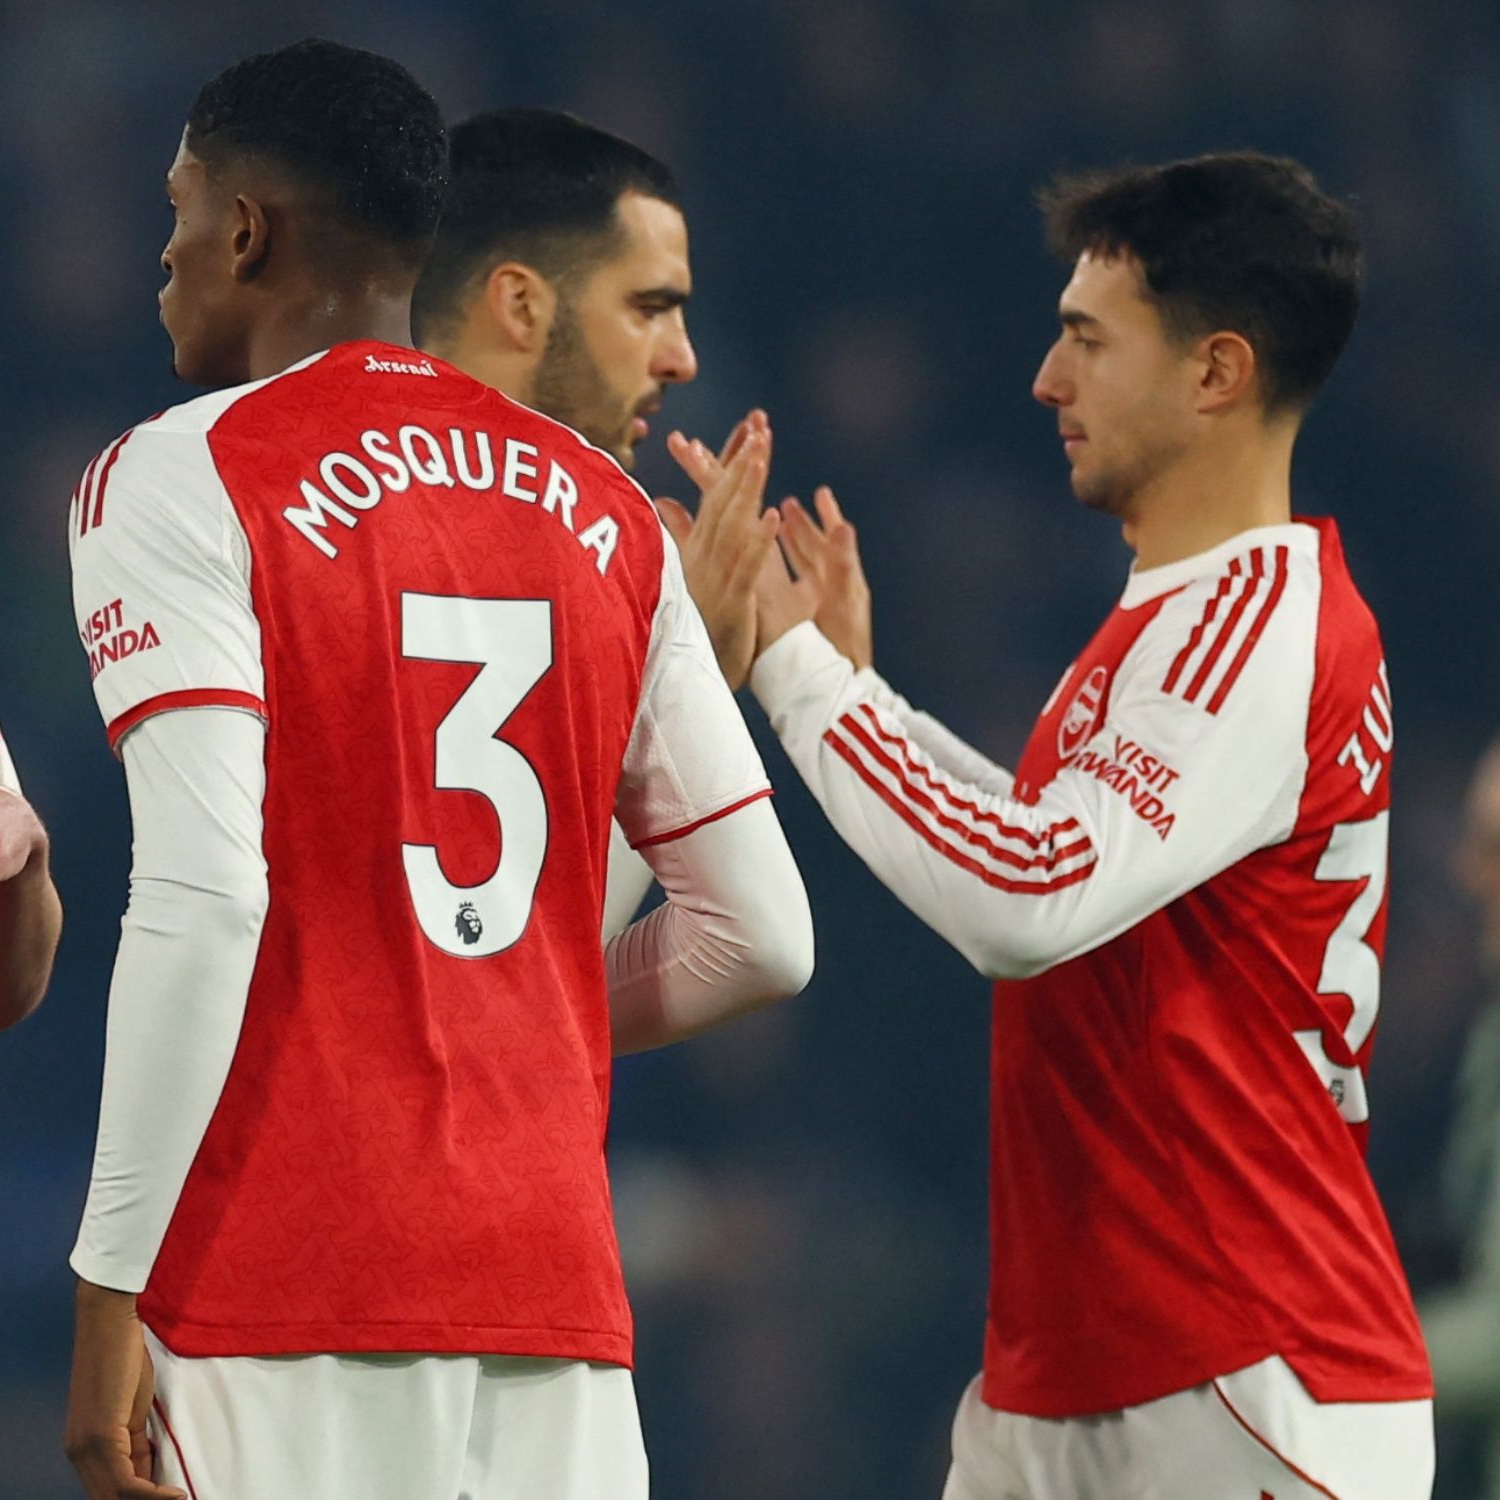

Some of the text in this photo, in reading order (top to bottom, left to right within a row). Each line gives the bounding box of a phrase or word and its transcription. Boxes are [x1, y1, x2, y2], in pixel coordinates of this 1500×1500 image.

[364, 354, 438, 377] Arsenal
[283, 424, 619, 576] MOSQUERA
[400, 591, 553, 959] 3
[1114, 735, 1181, 794] VISIT
